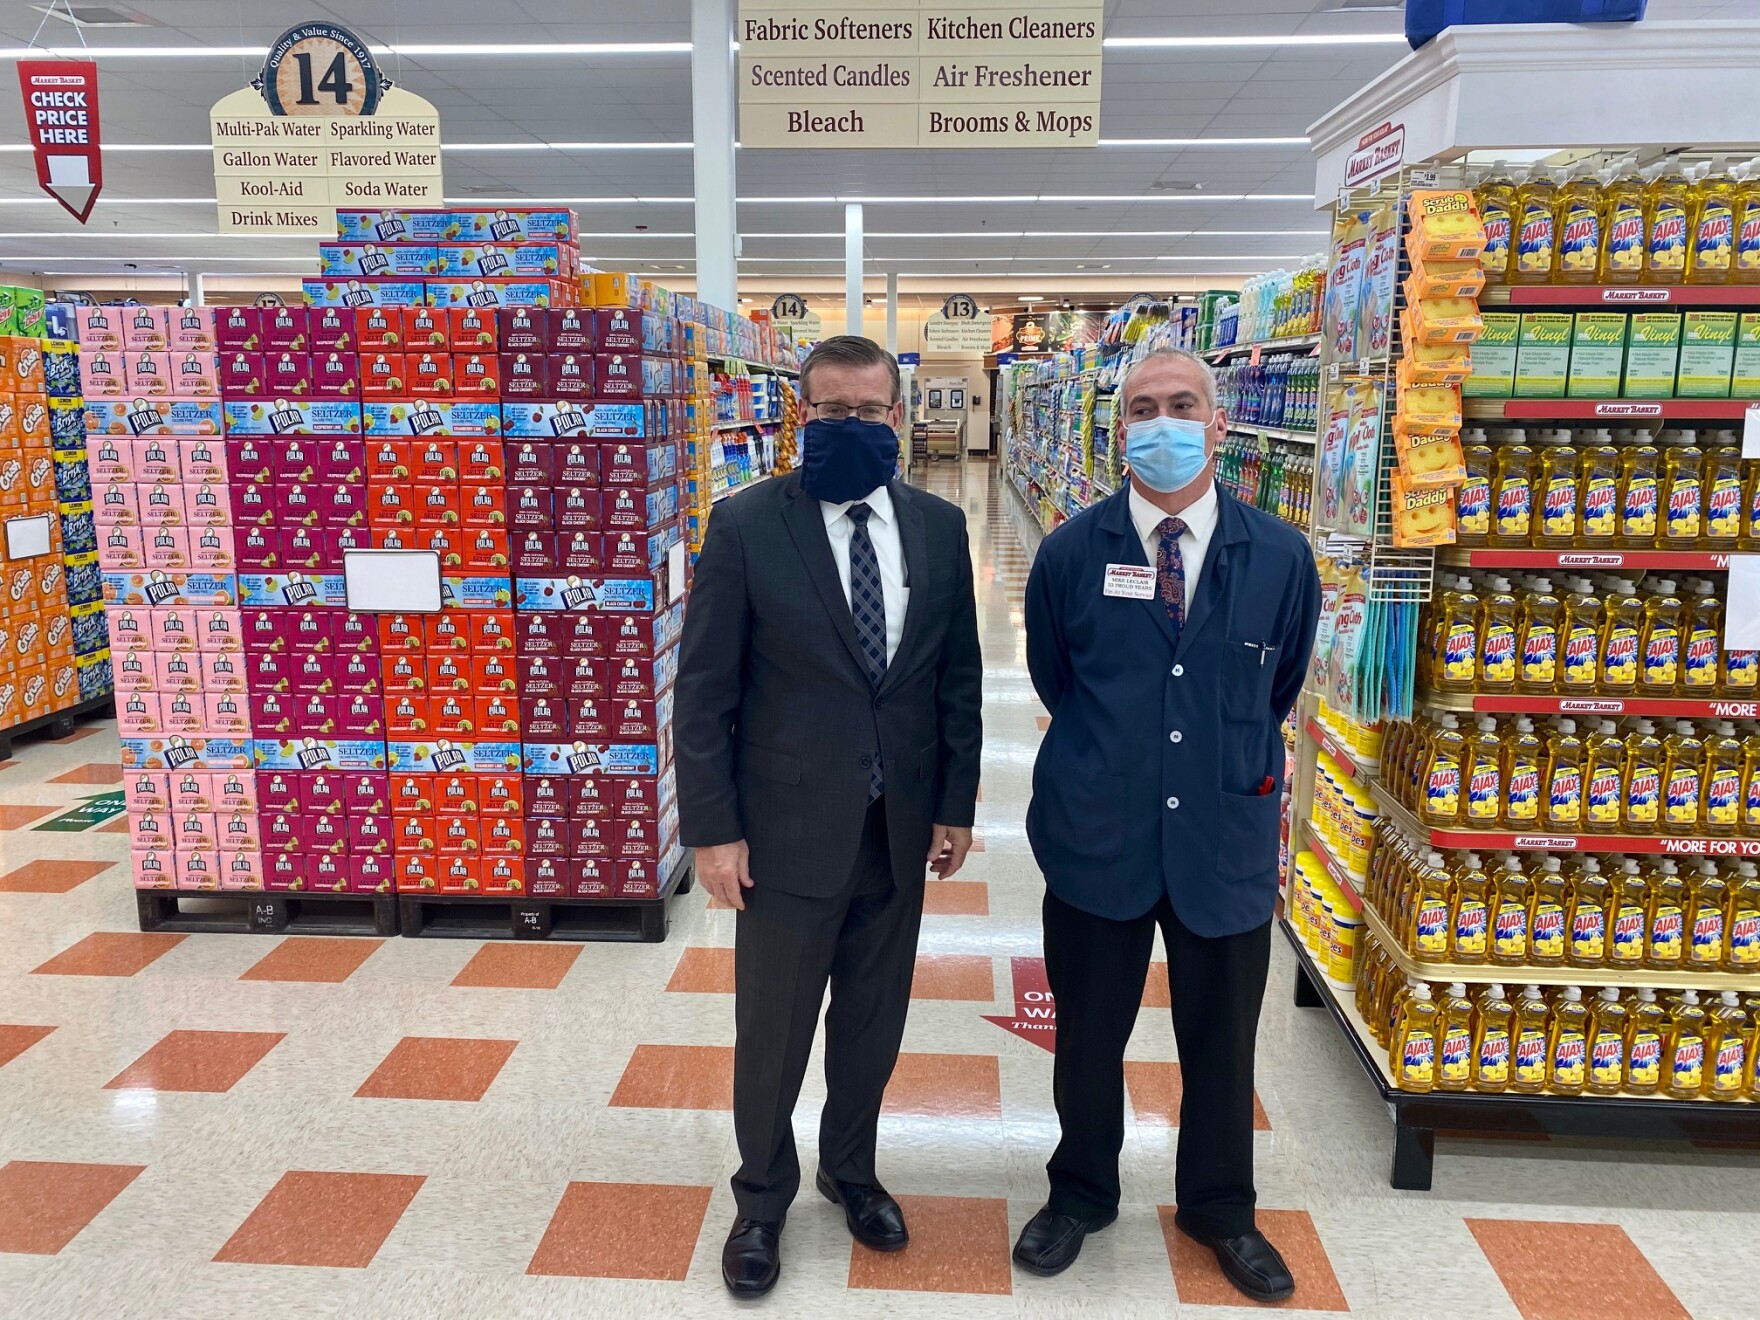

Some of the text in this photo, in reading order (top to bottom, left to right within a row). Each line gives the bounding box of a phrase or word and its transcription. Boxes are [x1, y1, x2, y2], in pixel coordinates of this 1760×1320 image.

[745, 17, 912, 41] Fabric Softeners
[928, 16, 1095, 40] Kitchen Cleaners
[270, 26, 371, 69] Quality & Value Since 1917
[292, 51, 353, 105] 14
[751, 64, 910, 87] Scented Candles
[933, 64, 1092, 87] Air Freshener
[31, 91, 88, 107] CHECK
[35, 110, 88, 126] PRICE
[788, 110, 865, 133] Bleach
[929, 110, 1092, 138] Brooms & Mops
[39, 128, 88, 144] HERE
[216, 122, 321, 136] Multi-Pak Water
[331, 121, 435, 139] Sparkling Water
[223, 152, 318, 166] Gallon Water
[331, 152, 437, 166] Flavored Water
[1348, 139, 1400, 179] MARKET BASKET
[240, 181, 303, 196] Kool-Aid
[345, 182, 428, 196] Soda Water
[1423, 195, 1455, 208] Scrub
[1426, 201, 1469, 215] Daddy
[231, 211, 318, 226] Drink Mixes
[412, 219, 448, 227] SELTZER
[379, 219, 403, 238] POLAR
[494, 219, 518, 238] POLAR
[1524, 224, 1547, 240] AJAX
[1616, 223, 1637, 238] AJAX
[1702, 222, 1726, 238] AJAX
[362, 254, 386, 275] POLAR
[395, 253, 431, 261] SELTZER
[481, 254, 505, 275] POLAR
[515, 253, 551, 262] SELTZER
[1605, 291, 1668, 300] MARKET BASKET
[781, 301, 798, 316] 14
[952, 302, 970, 317] 13
[1531, 325, 1569, 345] Vinyl
[1585, 325, 1623, 345] Vinyl
[1641, 325, 1678, 345] Vinyl
[1695, 324, 1733, 344] Vinyl
[171, 410, 212, 420] SELTZER
[311, 409, 352, 419] SELTZER
[451, 411, 493, 420] SELTZER
[594, 412, 636, 422] SELTZER
[1598, 405, 1659, 414] MARKET BASKET
[132, 411, 161, 432] POLAR
[272, 411, 302, 432] POLAR
[412, 411, 442, 433] POLAR
[555, 413, 583, 433] POLAR
[1406, 490, 1448, 510] Daddy
[1462, 489, 1484, 505] AJAX
[1502, 490, 1524, 506] AJAX
[1628, 491, 1652, 506] AJAX
[1712, 492, 1735, 507] AJAX
[1560, 555, 1621, 565] MARKET BASKET
[149, 584, 177, 603] POLAR
[286, 583, 314, 603] POLAR
[604, 587, 645, 596] SELTZER
[565, 591, 594, 610] POLAR
[1449, 637, 1471, 651] AJAX
[1609, 640, 1633, 655] AJAX
[1690, 641, 1713, 657] AJAX
[1562, 702, 1621, 711] MARKET BASKET
[169, 748, 197, 766] POLAR
[434, 751, 462, 769] POLAR
[571, 754, 600, 773] POLAR
[1432, 773, 1455, 787] AJAX
[1671, 781, 1694, 795] AJAX
[1517, 838, 1575, 848] MARKET BASKET
[1710, 841, 1734, 854] FOR
[256, 904, 274, 915] A-B
[524, 916, 537, 924] A-B
[1418, 911, 1443, 925] AJAX
[1536, 916, 1559, 930] AJAX
[1024, 991, 1055, 1002] ON
[1011, 1021, 1057, 1030] Than
[1407, 1043, 1428, 1056] AJAX
[1517, 1040, 1541, 1056] AJAX
[1677, 1048, 1699, 1062] AJAX
